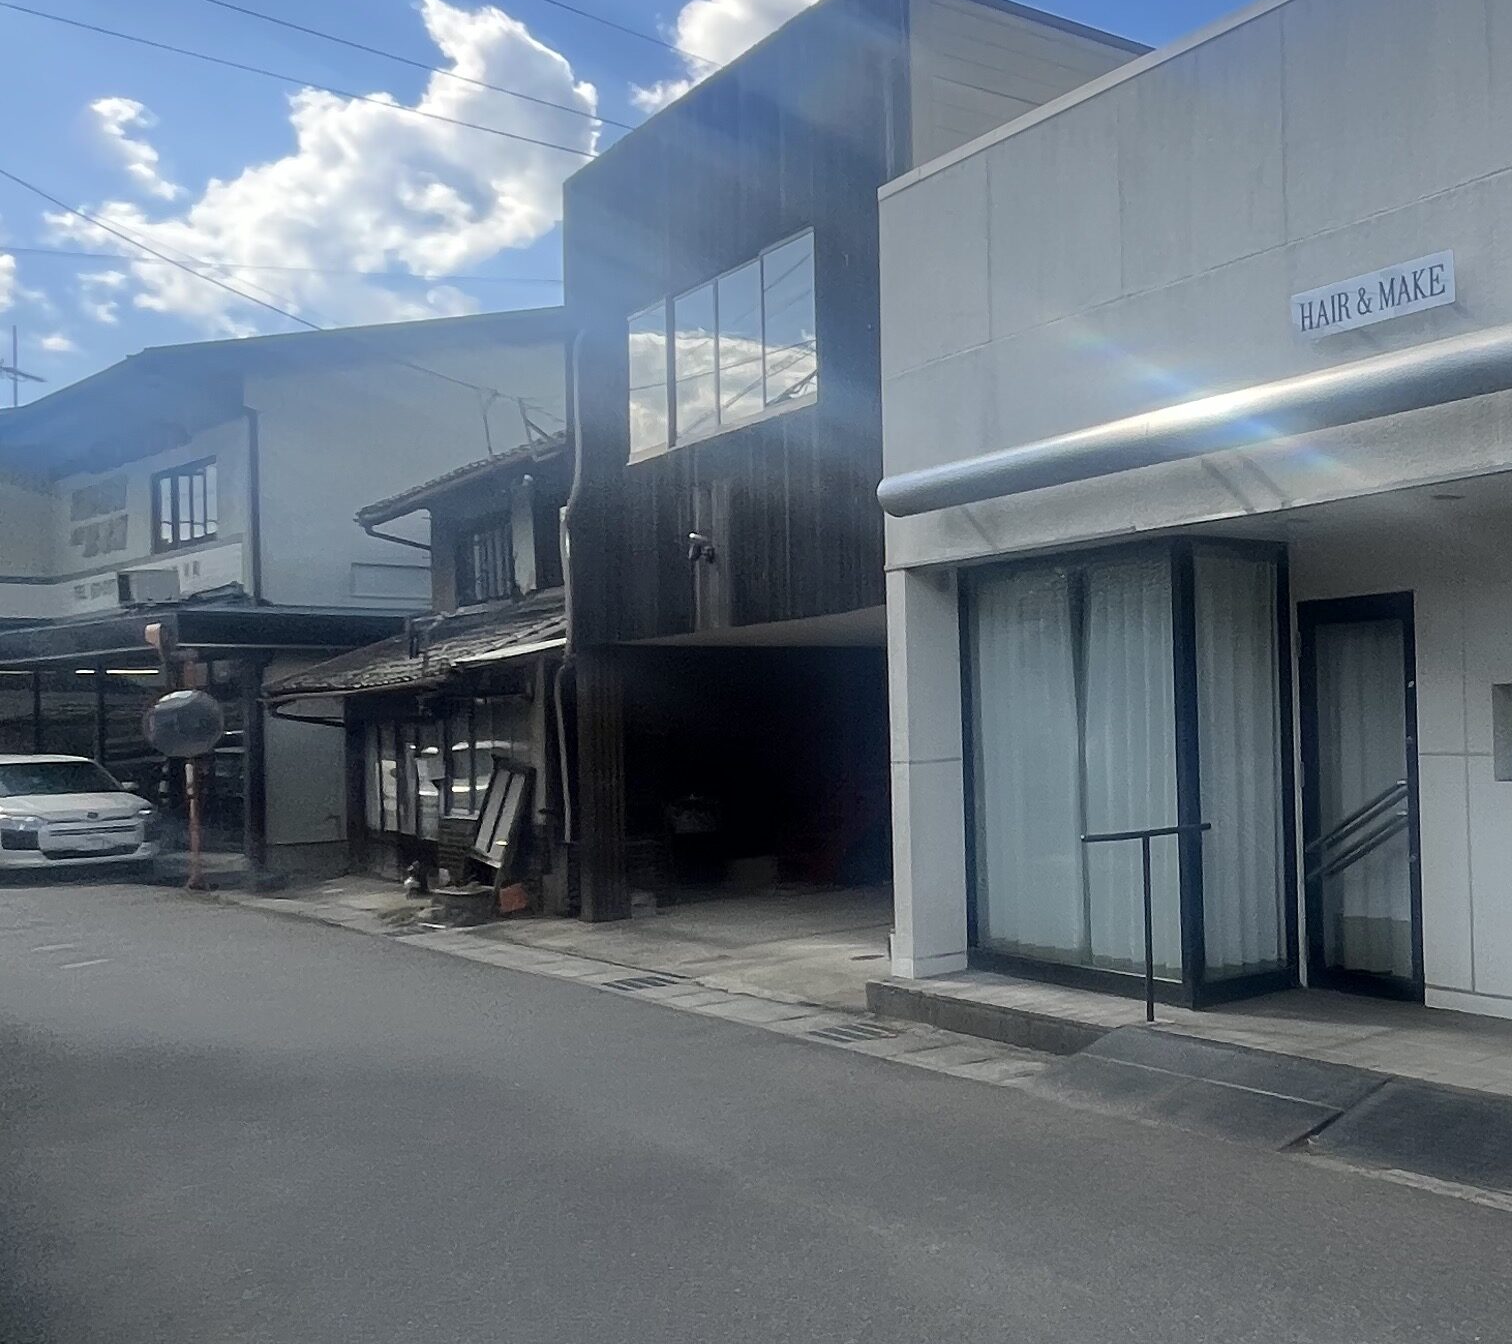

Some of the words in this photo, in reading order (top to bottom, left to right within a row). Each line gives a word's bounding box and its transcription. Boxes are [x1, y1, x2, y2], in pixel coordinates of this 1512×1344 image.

[1300, 291, 1352, 332] HAIR
[1357, 287, 1373, 316] &
[1378, 263, 1446, 311] MAKE
